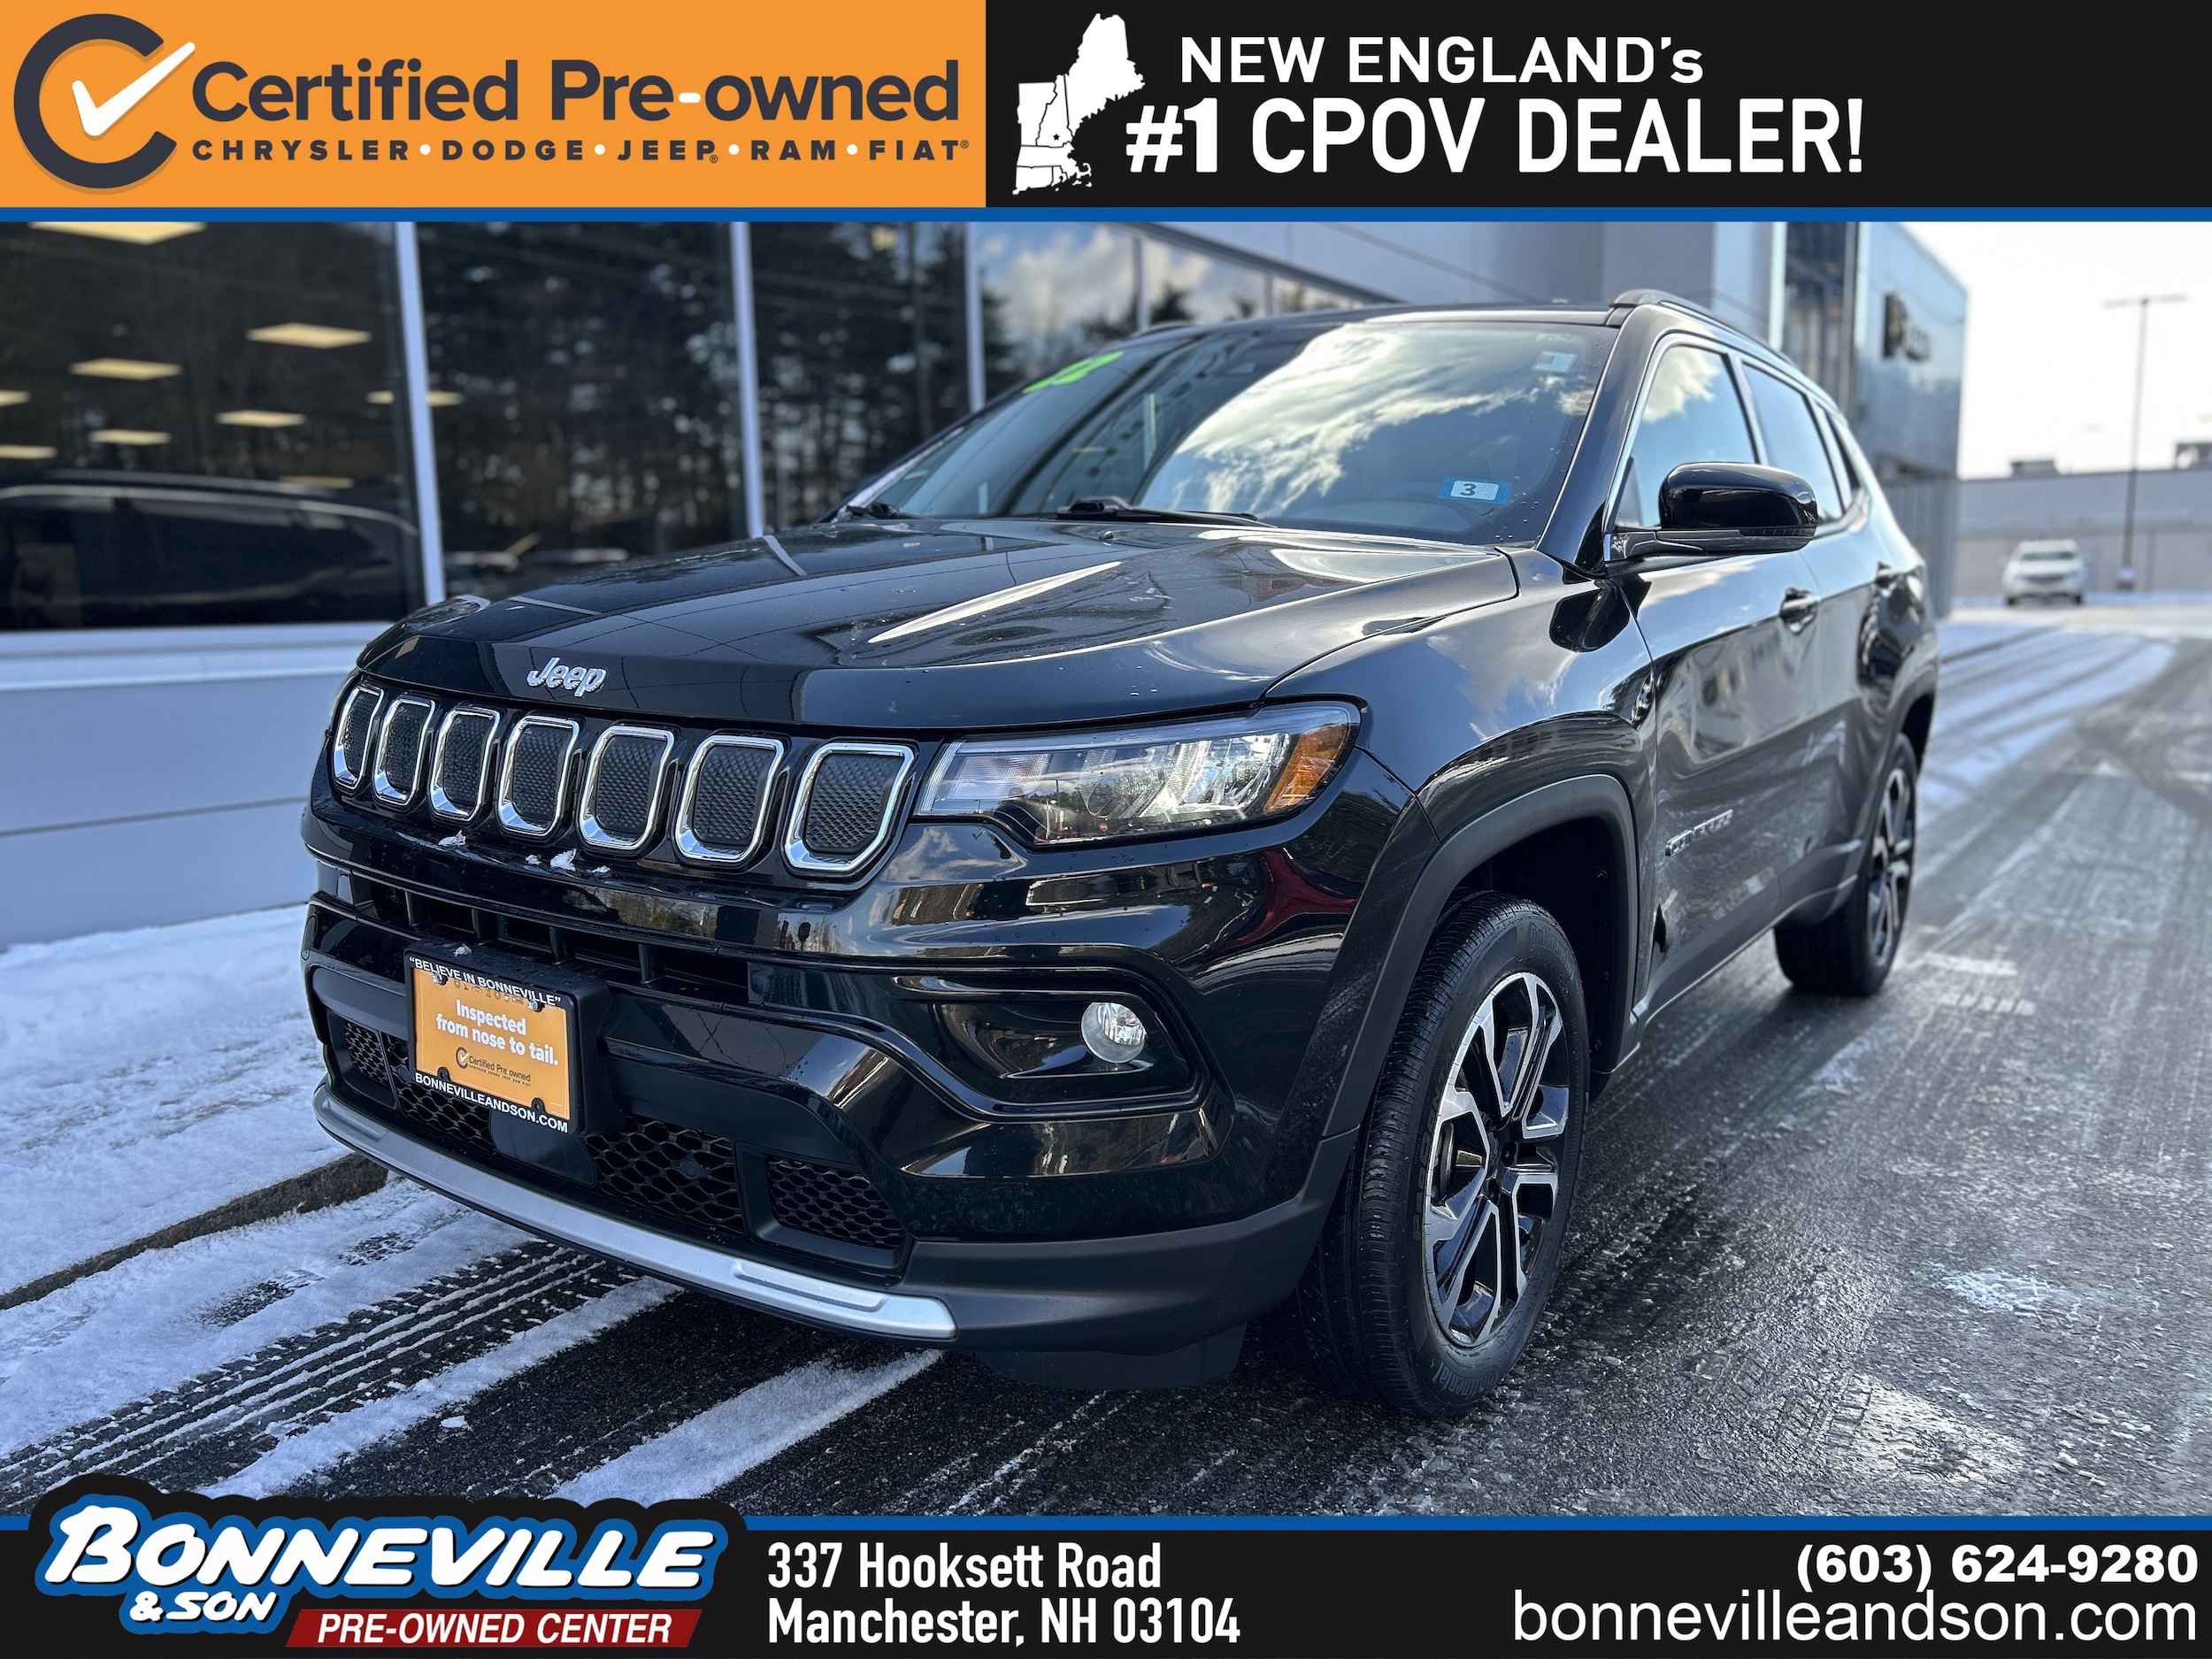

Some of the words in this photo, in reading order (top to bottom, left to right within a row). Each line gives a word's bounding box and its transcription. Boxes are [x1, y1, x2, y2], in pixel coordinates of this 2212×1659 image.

[1460, 483, 1477, 496] 3
[526, 657, 607, 698] Jeep
[463, 972, 476, 984] IN
[456, 999, 526, 1036] Inspected
[436, 1013, 468, 1039] from
[472, 1028, 505, 1050] nose
[510, 1036, 526, 1056] to
[529, 1041, 559, 1066] tail.
[415, 1072, 568, 1133] BONNEVILLEANDSON.COM
[1432, 1360, 1500, 1400] Continental
